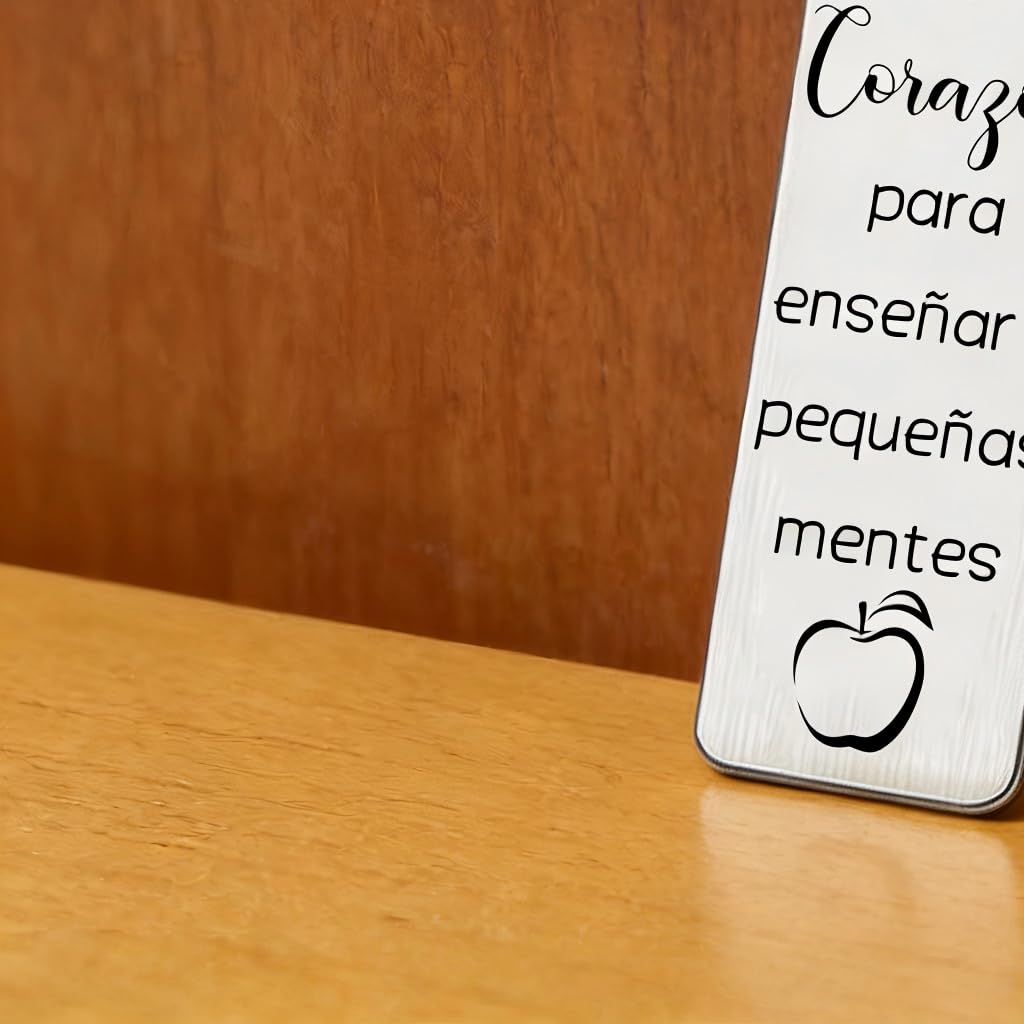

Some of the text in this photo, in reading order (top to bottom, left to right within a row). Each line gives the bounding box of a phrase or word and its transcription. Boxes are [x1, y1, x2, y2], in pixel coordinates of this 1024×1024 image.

[866, 184, 1006, 236] para
[773, 286, 1017, 351] enseñar
[773, 516, 1001, 582] mentes
